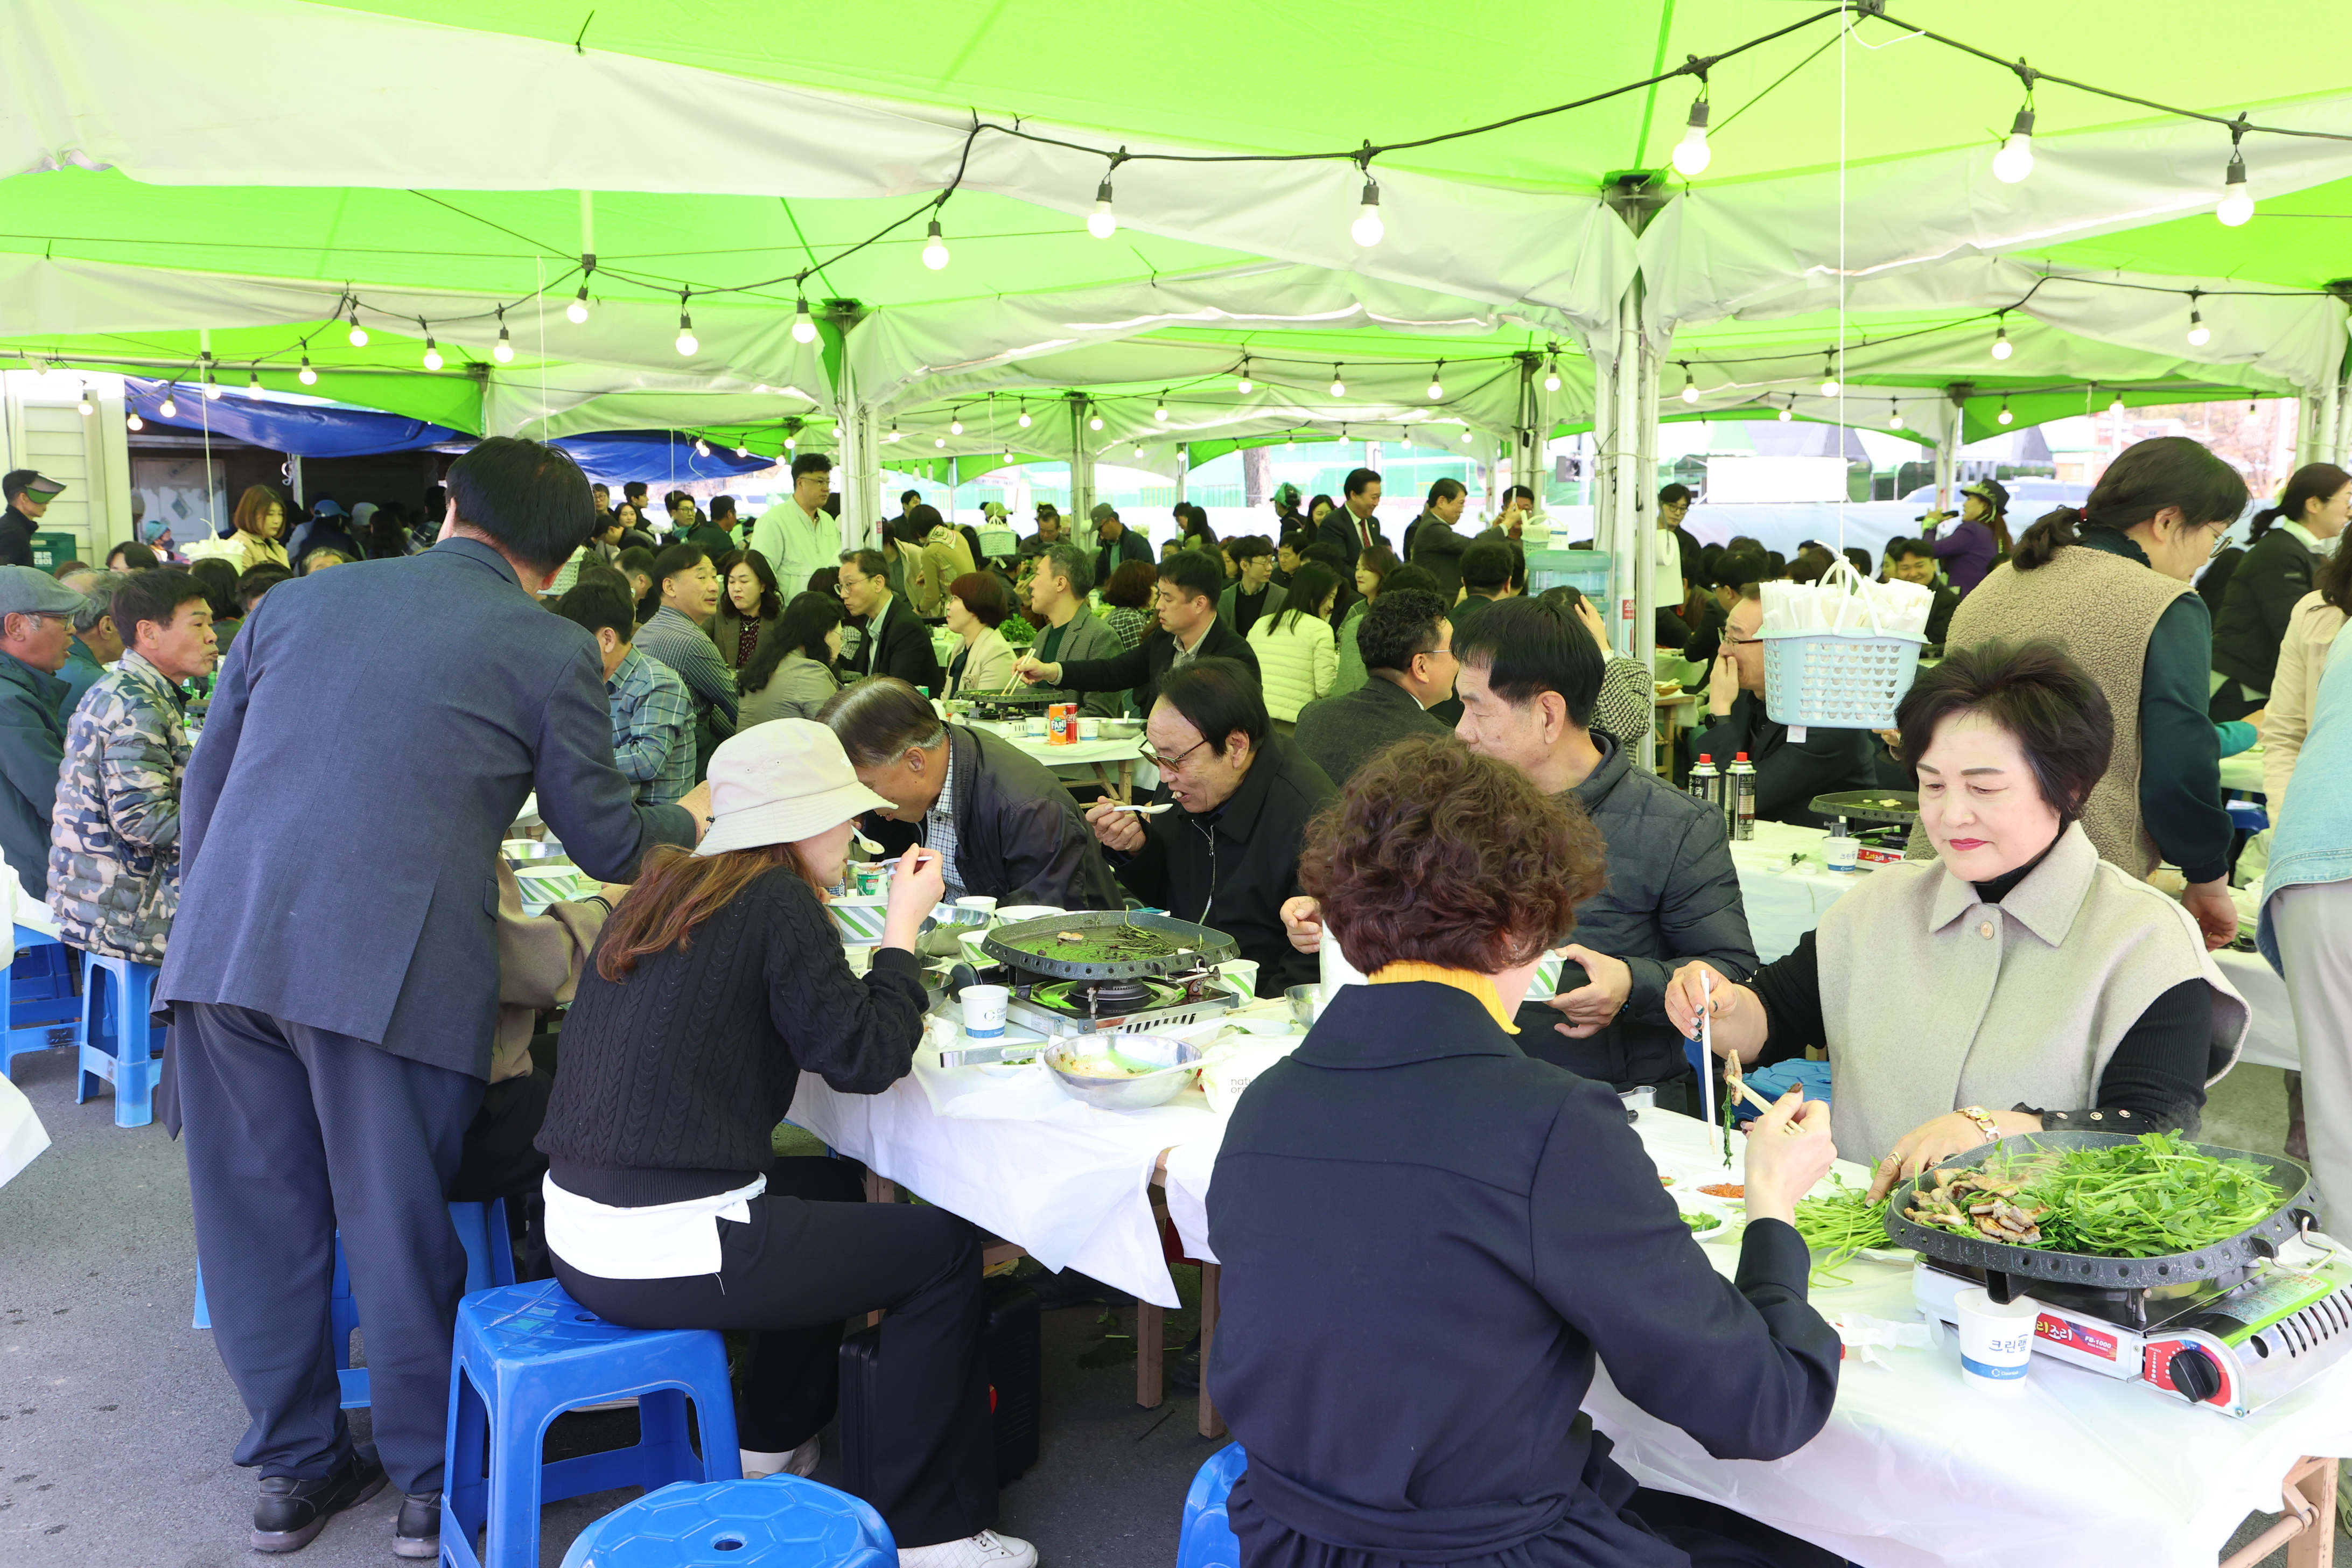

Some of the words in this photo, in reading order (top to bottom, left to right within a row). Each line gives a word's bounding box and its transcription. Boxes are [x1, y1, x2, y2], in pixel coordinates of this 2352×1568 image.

[1051, 719, 1067, 730] FANT
[2035, 1321, 2073, 1341] 리조리
[2084, 1335, 2112, 1349] FB-1000
